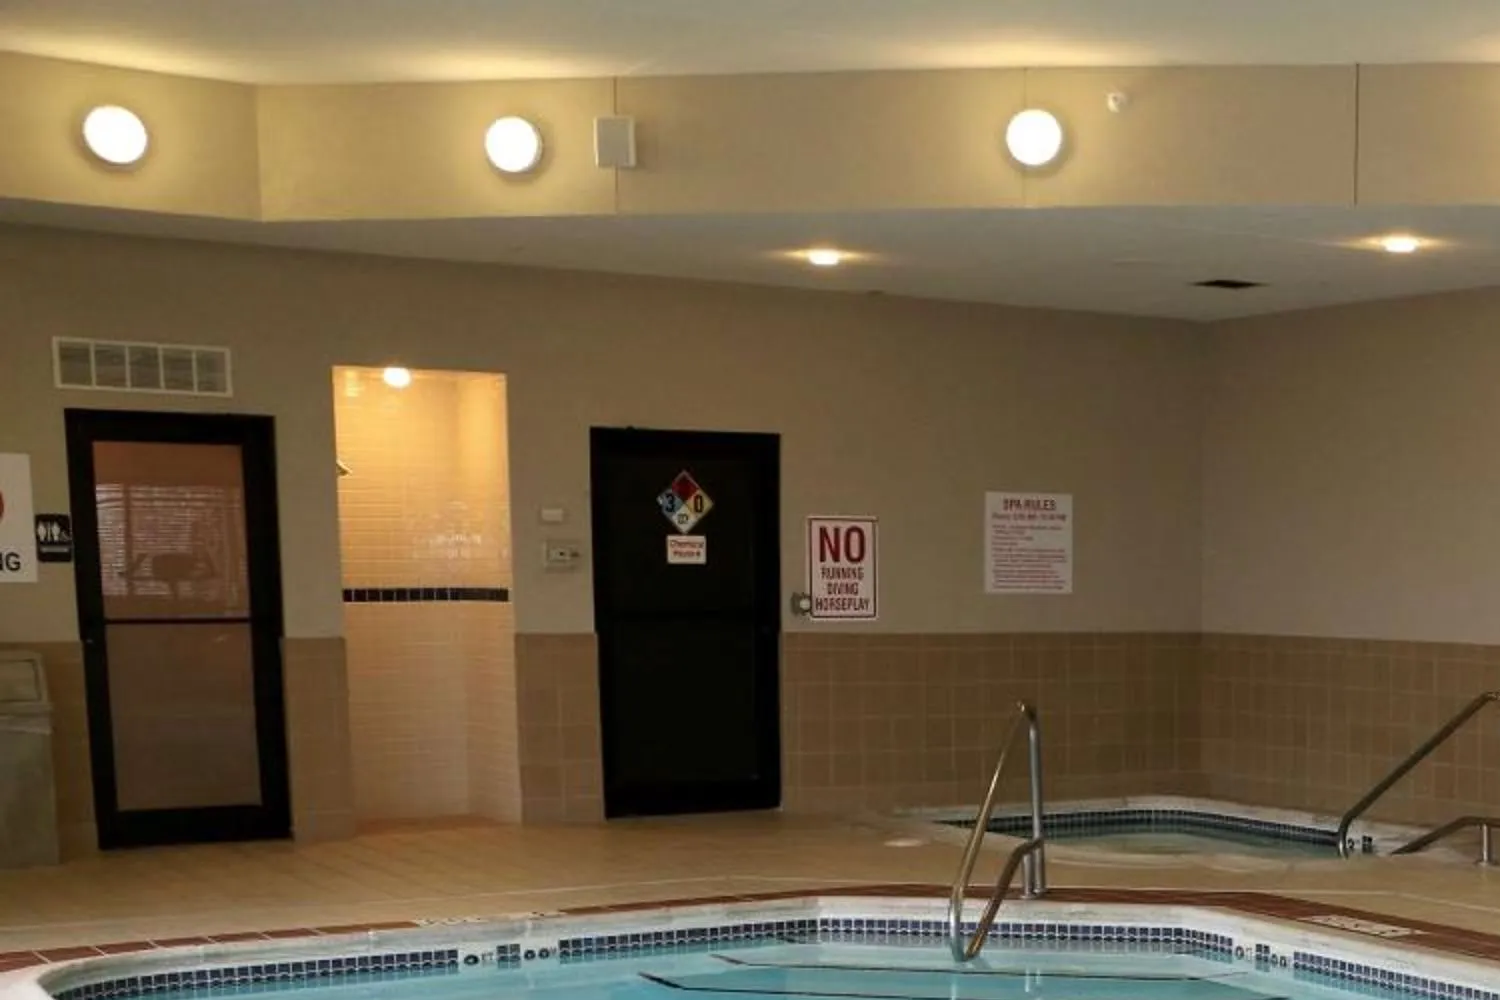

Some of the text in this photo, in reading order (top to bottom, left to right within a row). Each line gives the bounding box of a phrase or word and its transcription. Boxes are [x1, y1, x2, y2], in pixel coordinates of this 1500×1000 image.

[819, 526, 866, 563] NO
[0, 552, 21, 572] G
[821, 567, 864, 580] RUNNING
[827, 583, 859, 595] DIVING
[815, 598, 870, 611] HORSEPLAY
